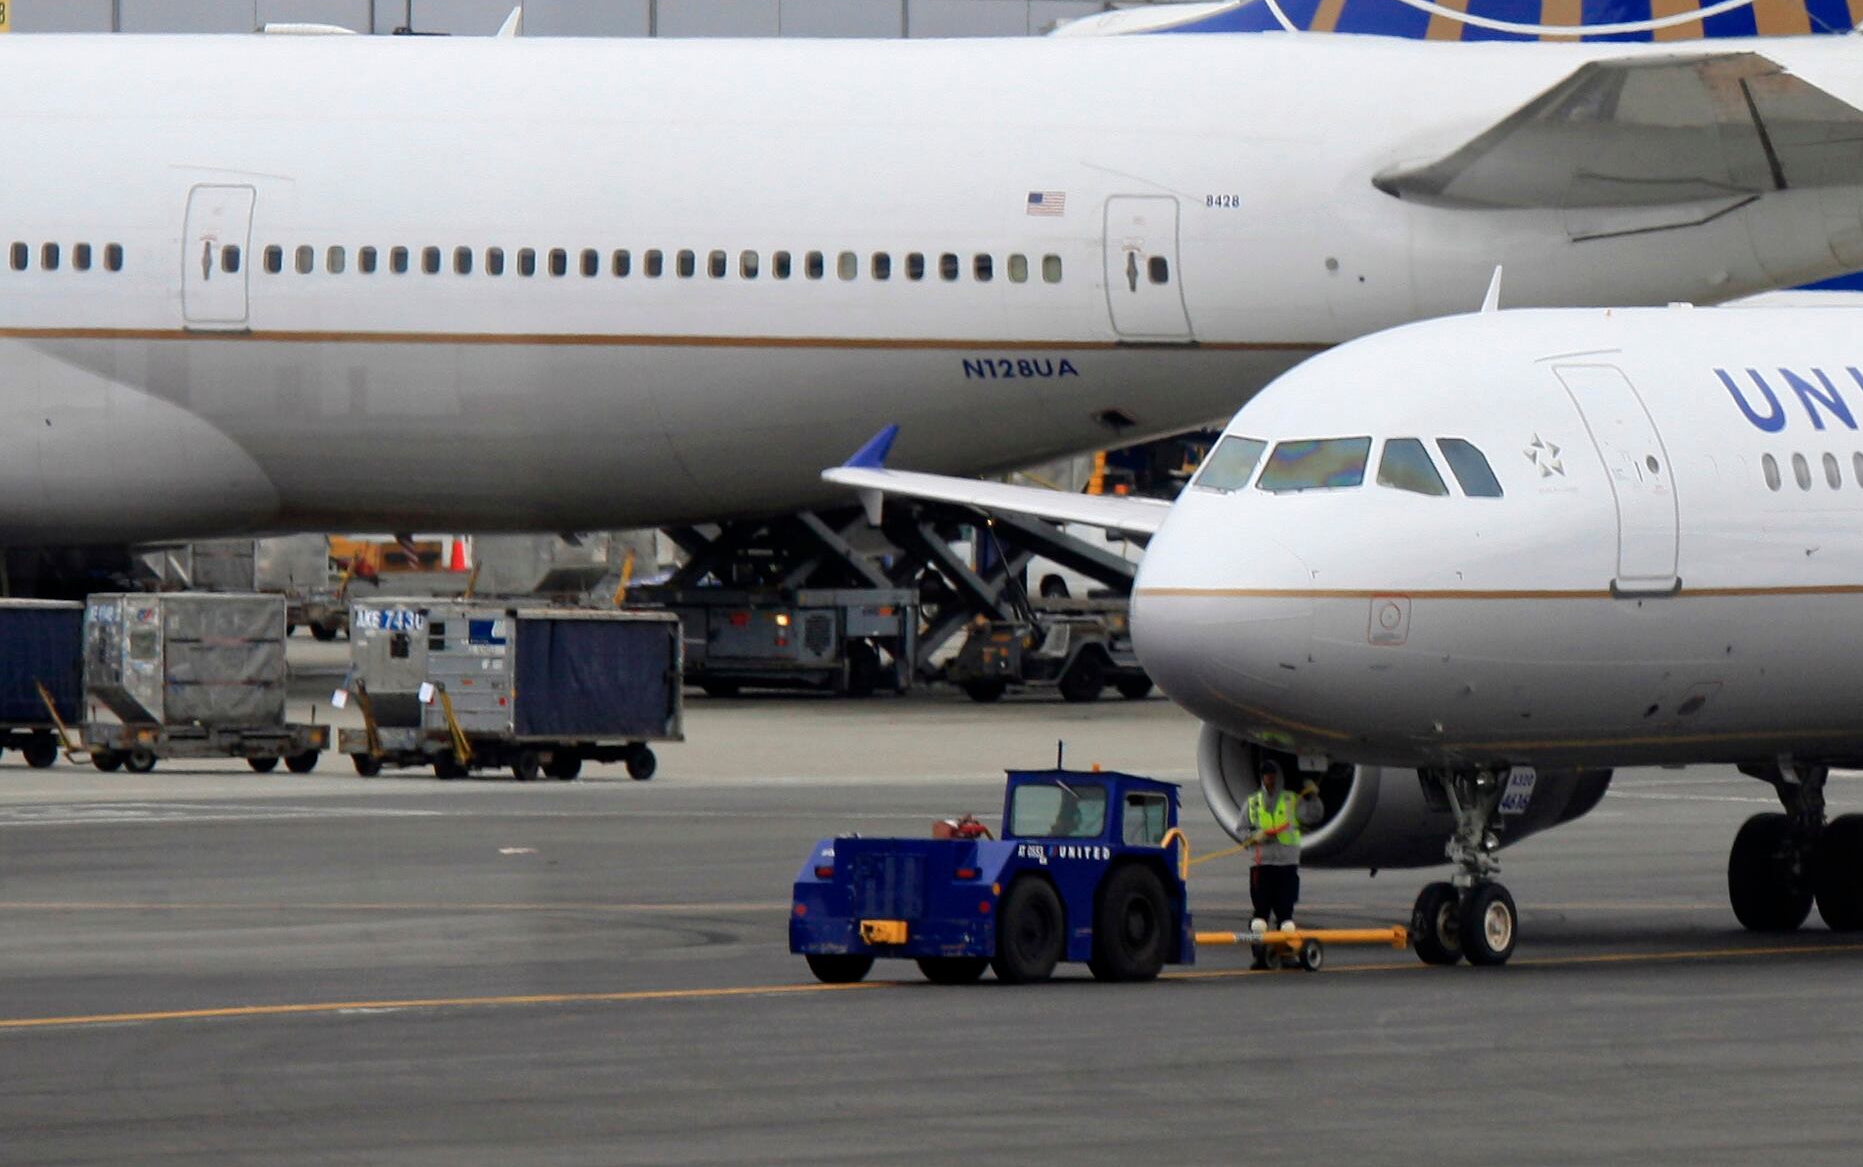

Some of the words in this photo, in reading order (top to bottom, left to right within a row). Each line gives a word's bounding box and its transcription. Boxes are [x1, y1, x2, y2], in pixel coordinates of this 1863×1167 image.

[1206, 194, 1240, 208] 8428
[962, 358, 1079, 379] N128UA
[1059, 845, 1110, 861] UNITED
